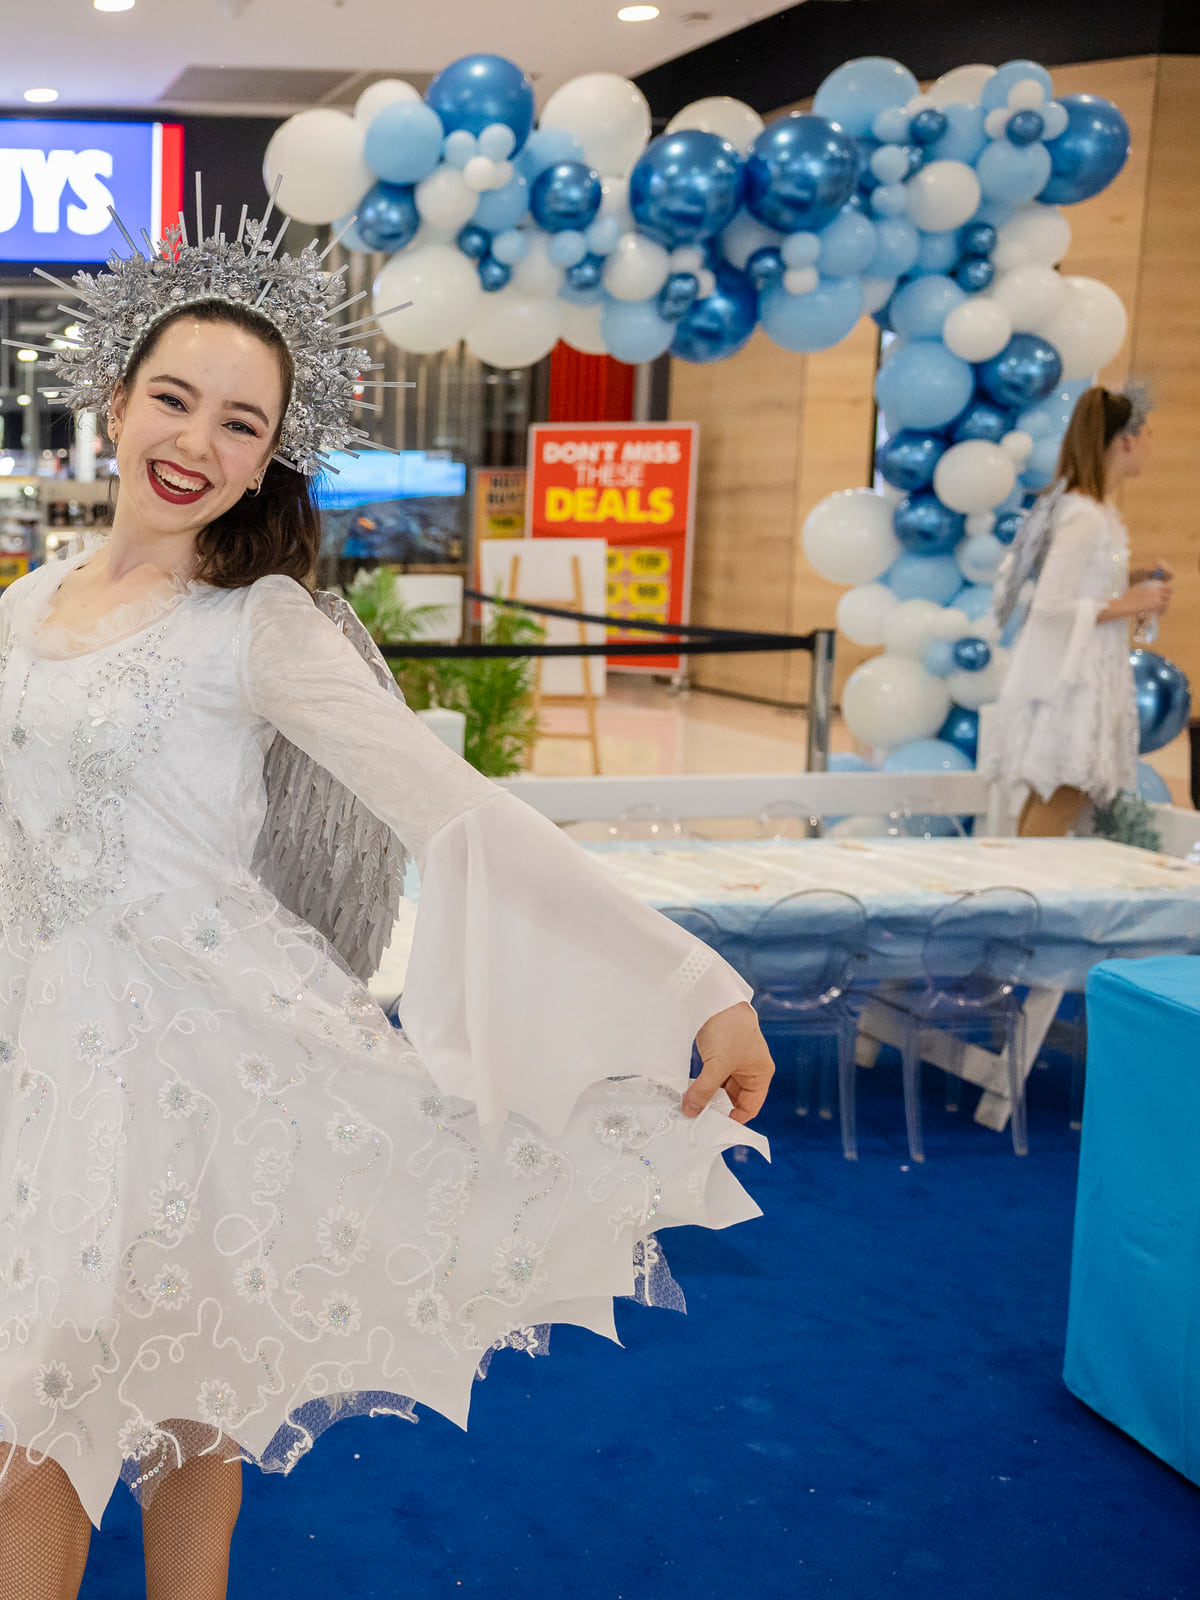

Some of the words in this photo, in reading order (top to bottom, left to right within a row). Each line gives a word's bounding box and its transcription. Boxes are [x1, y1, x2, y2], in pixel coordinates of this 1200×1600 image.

[621, 440, 682, 464] MISS
[574, 463, 645, 487] THESE
[545, 487, 674, 524] DEALS
